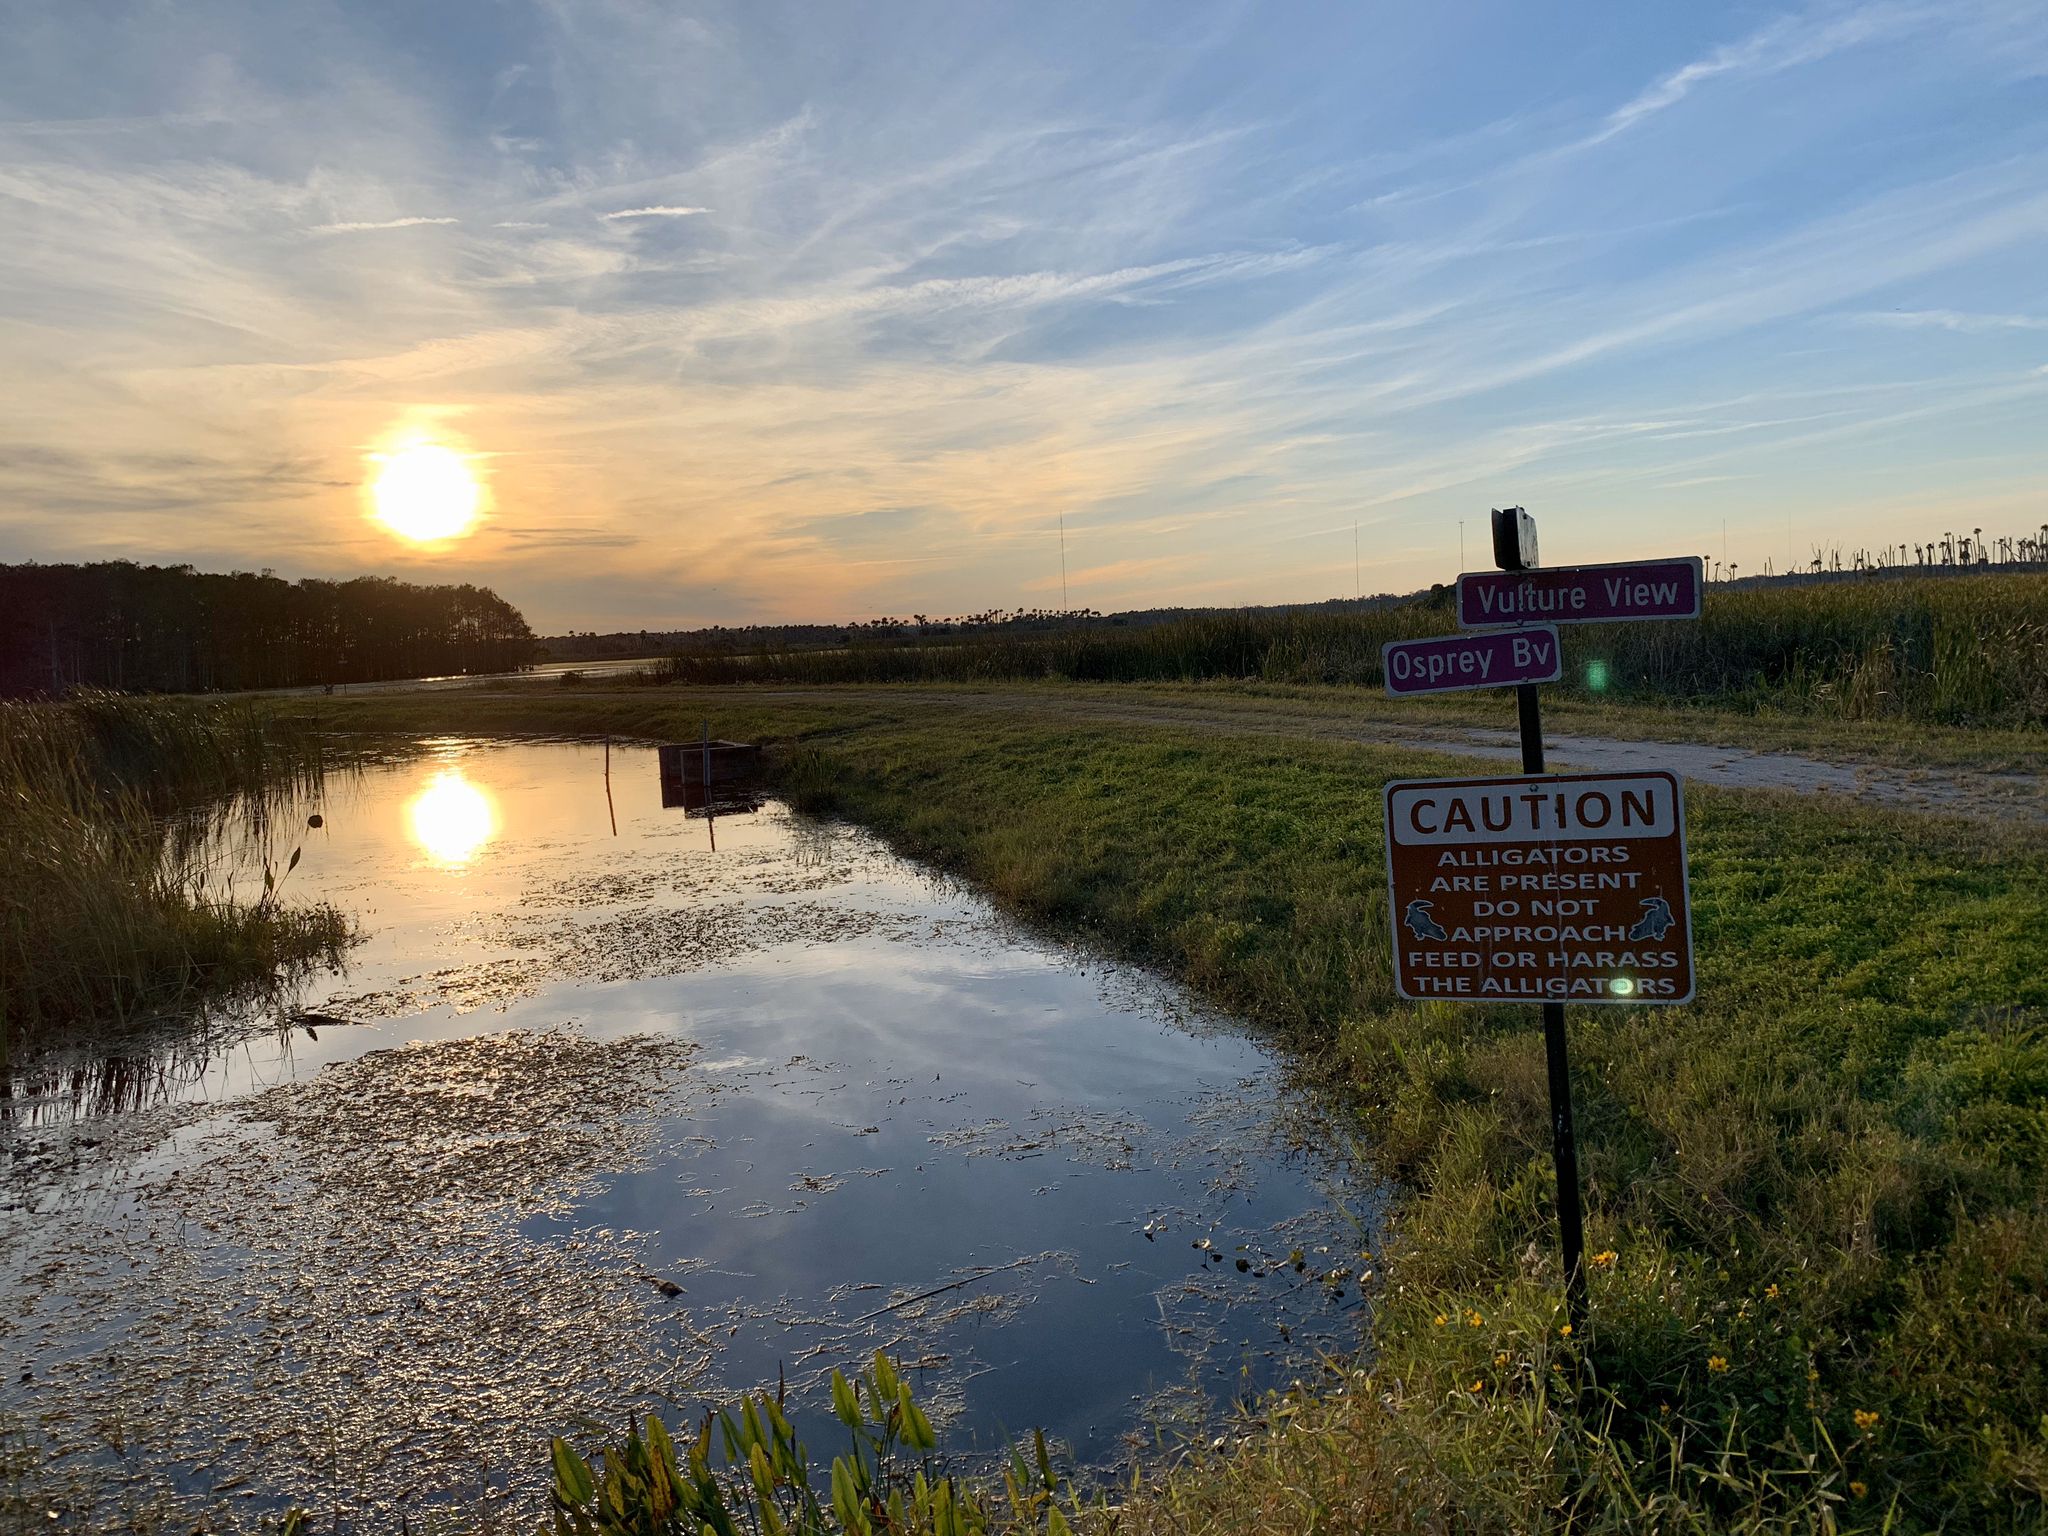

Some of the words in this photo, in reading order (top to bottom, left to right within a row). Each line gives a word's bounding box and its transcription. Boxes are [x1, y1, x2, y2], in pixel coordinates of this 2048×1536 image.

[1478, 581, 1586, 614] Vulture
[1603, 576, 1678, 607] View
[1392, 648, 1494, 683] Osprey
[1512, 637, 1550, 668] Bv
[1410, 789, 1656, 834] CAUTION
[1437, 846, 1630, 867] ALLIGATORS
[1430, 876, 1489, 892] ARE
[1500, 872, 1642, 891] PRESENT
[1473, 900, 1520, 917] DO
[1531, 899, 1600, 916] NOT
[1450, 925, 1626, 943] APPROACH
[1408, 951, 1481, 968] FEED
[1491, 951, 1537, 968] OR
[1547, 951, 1679, 968] HARASS
[1413, 976, 1471, 993] THE
[1481, 977, 1676, 995] ALLIGATORS
